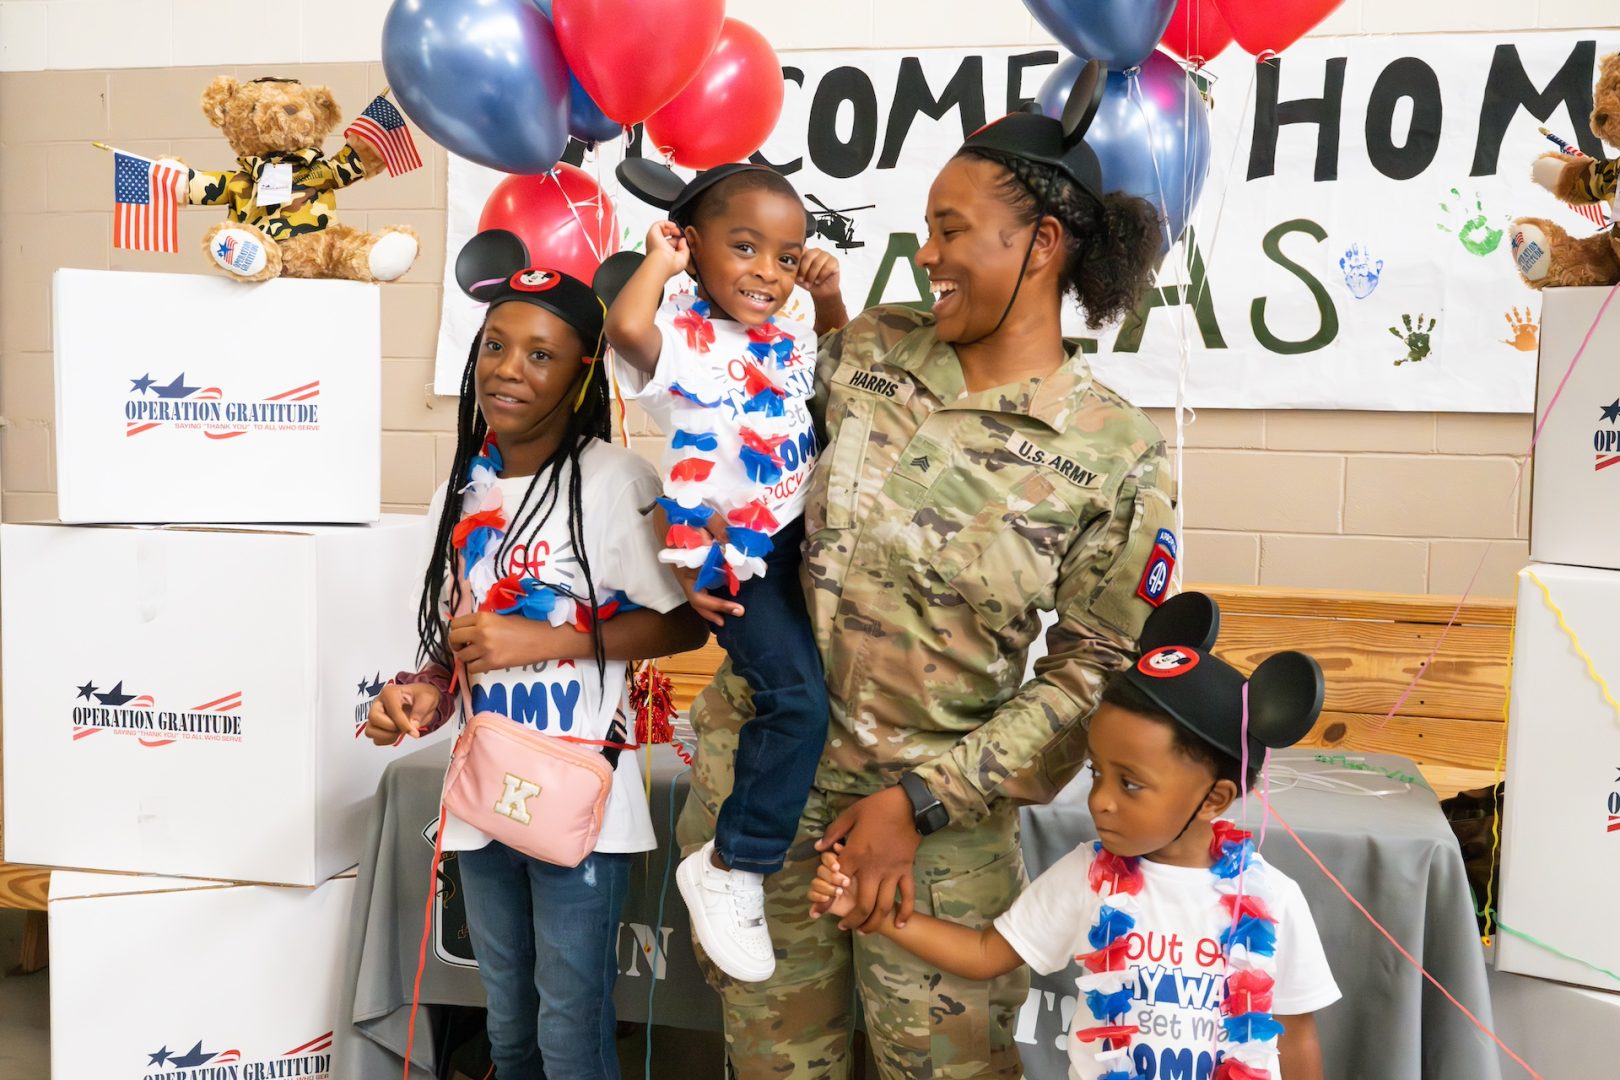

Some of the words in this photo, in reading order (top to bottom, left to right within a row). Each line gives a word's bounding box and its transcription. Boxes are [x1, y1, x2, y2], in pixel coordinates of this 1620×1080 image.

[1246, 40, 1606, 182] HOM
[849, 370, 899, 398] HARRIS
[125, 400, 221, 422] OPERATION
[225, 402, 318, 423] GRATITUDE
[1018, 440, 1045, 464] U.S.
[1047, 455, 1099, 486] ARMY
[72, 706, 154, 730] OPERATION
[158, 711, 242, 735] GRATITUDE
[472, 680, 581, 732] MMY
[494, 772, 542, 826] K
[1137, 1009, 1182, 1040] get
